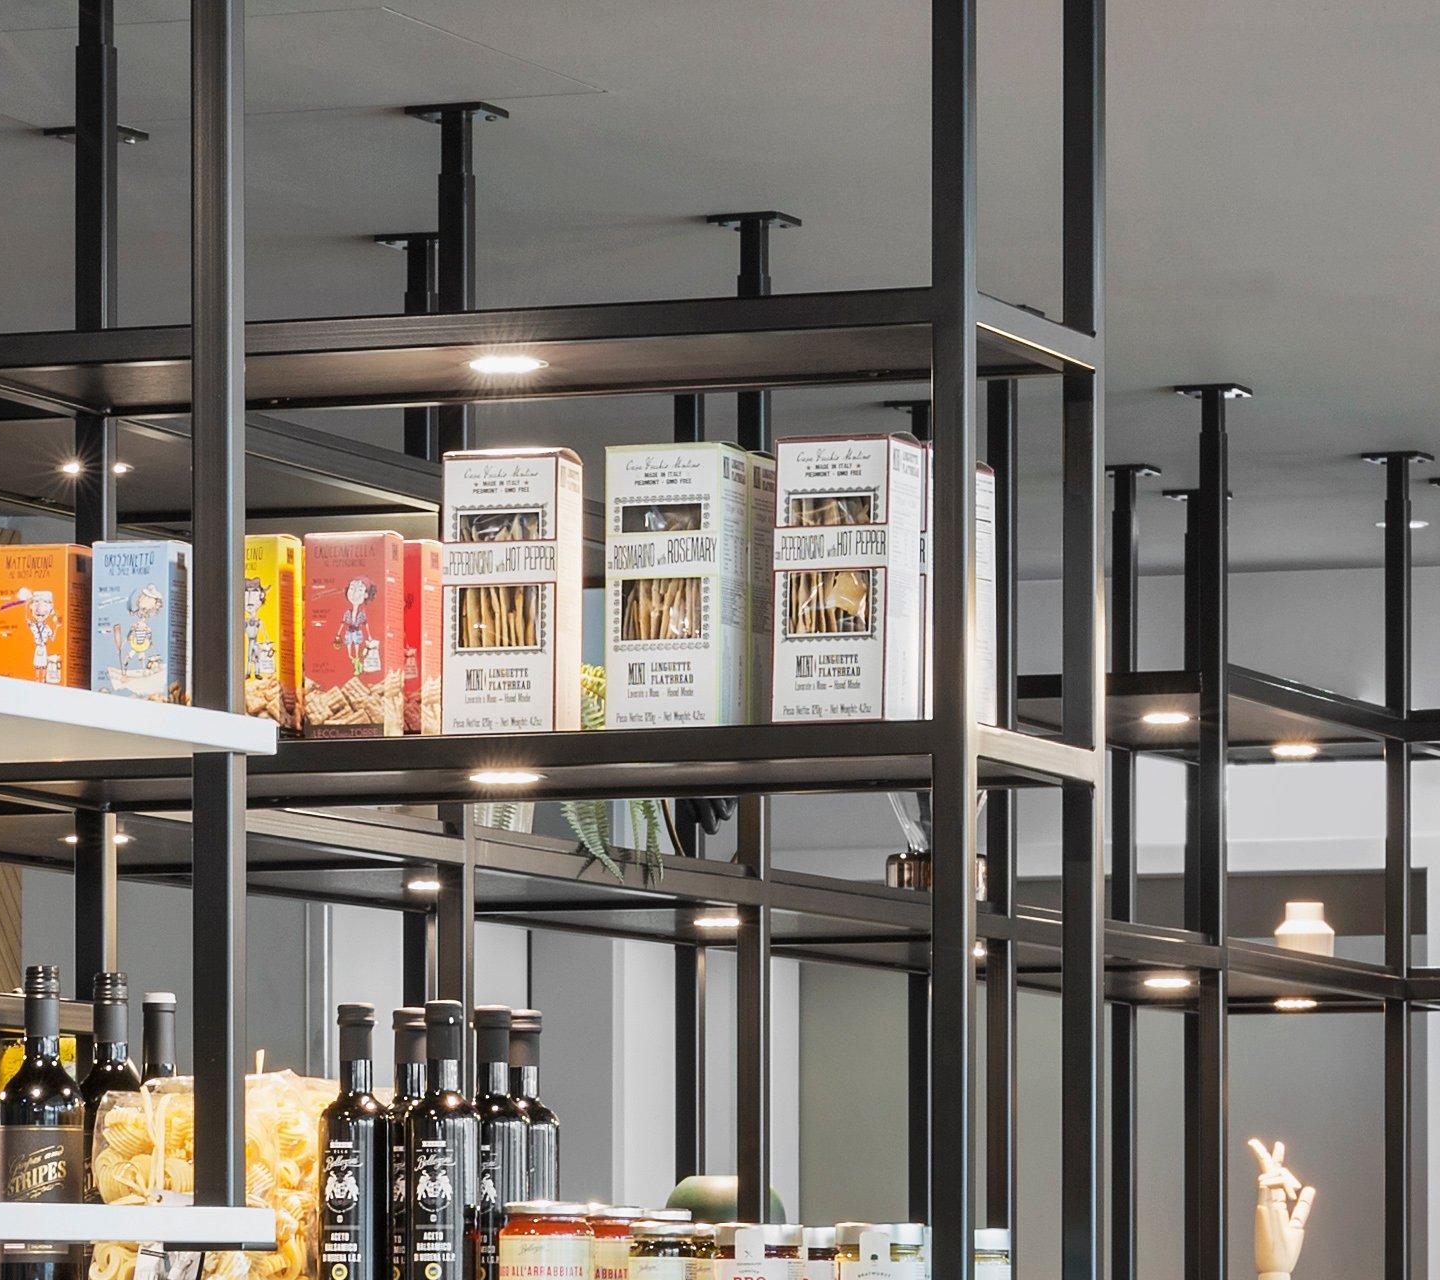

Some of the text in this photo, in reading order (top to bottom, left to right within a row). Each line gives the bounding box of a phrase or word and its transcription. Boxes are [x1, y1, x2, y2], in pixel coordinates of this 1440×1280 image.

[667, 538, 717, 564] ROSEMARY
[837, 530, 886, 557] HOT PEPPER
[524, 546, 555, 571] PEPPER
